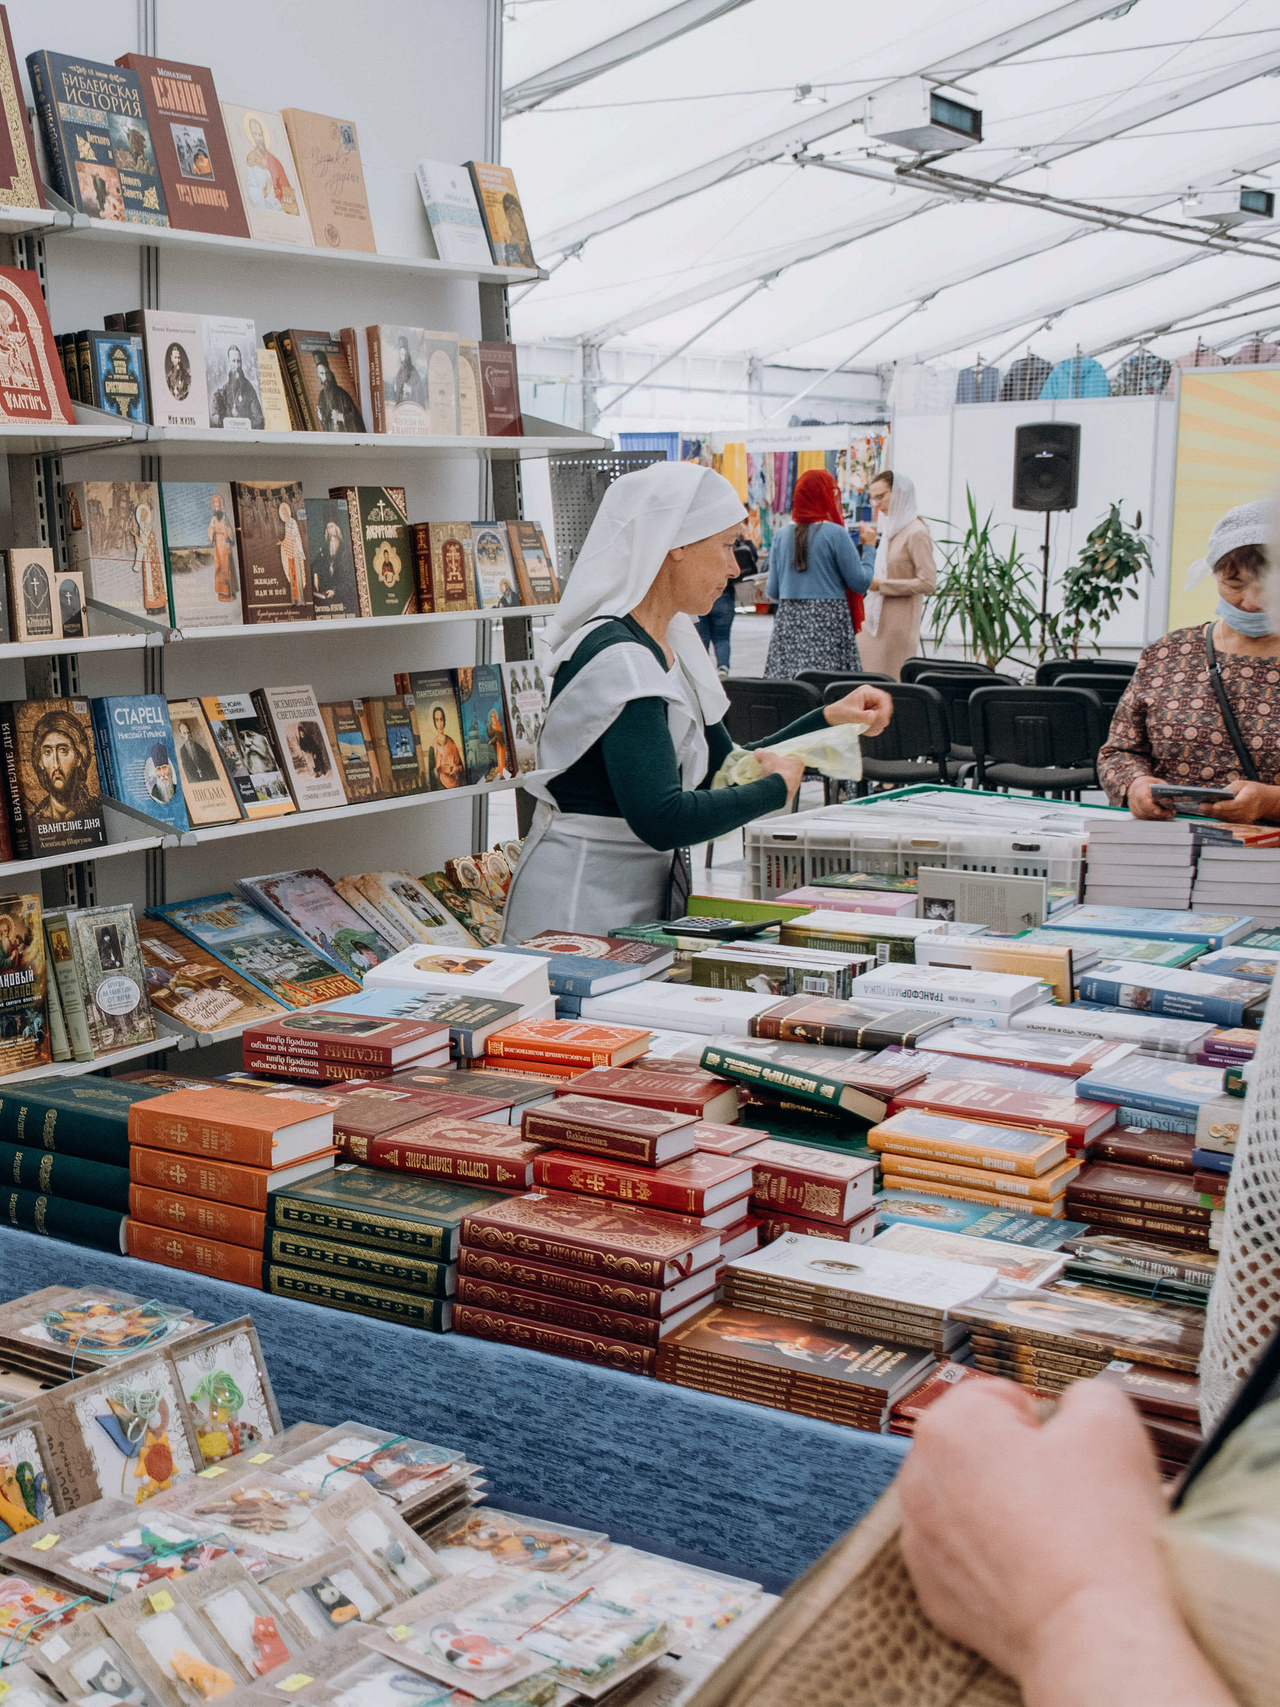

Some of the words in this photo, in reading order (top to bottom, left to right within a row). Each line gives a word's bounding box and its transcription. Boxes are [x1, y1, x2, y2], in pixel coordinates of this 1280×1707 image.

[62, 73, 139, 101] БИБЛЕЙСКАЯ
[65, 86, 143, 118] ИСТОРИЯ
[86, 131, 111, 147] Ветхого
[120, 173, 141, 188] Нового
[122, 187, 142, 200] Завета
[252, 564, 265, 574] Кто
[254, 577, 279, 586] жаждет,
[255, 589, 267, 597] иди
[275, 587, 287, 595] пей
[273, 697, 314, 710] ВСЕМИРНЫЙ
[114, 706, 164, 726] СТАРЕЦ
[276, 708, 317, 721] СВЕТИЛЬНИК
[0, 722, 13, 750] ДНЯ
[5, 751, 23, 822] ЕВАНГЕЛИЕ
[192, 786, 227, 803] ПИСЬМА
[38, 820, 82, 835] ЕВАНГЕЛИЕ
[83, 817, 101, 829] ДНЯ
[40, 838, 67, 849] Александр
[66, 836, 93, 847] Шаргунов
[863, 984, 944, 1003] ТРАНСФОРМАТУШКА
[178, 993, 218, 1019] Добрый
[201, 996, 235, 1020] портной
[250, 1042, 277, 1052] всякую
[266, 1035, 285, 1044] души
[286, 1037, 319, 1049] потребу
[266, 1055, 285, 1063] души
[288, 1047, 319, 1056] чтомые
[324, 1044, 384, 1063] ПСАЛМЫ
[504, 1046, 544, 1057] МОЛИТВОСЛОВ
[544, 1050, 591, 1062] ПРАВОСЛАВНЫЙ
[250, 1061, 277, 1071] всякую
[286, 1057, 319, 1067] потребу
[288, 1066, 319, 1075] чтомые
[762, 1067, 817, 1094] ПСАЛТИРЬ
[17, 1106, 28, 1139] БИБЛИЯ
[13, 1152, 23, 1183] БИБЛИЯ
[405, 1151, 453, 1174] ЕВАНГЕЛИЕ
[456, 1159, 489, 1179] СВЯТОЕ
[828, 1289, 848, 1298] ОПЫТ
[850, 1293, 897, 1310] ПОСТРОЕНИЯ
[898, 1303, 937, 1317] ИСПОВЕДИ
[826, 1309, 846, 1317] ОПЫТ
[848, 1313, 894, 1329] ПОСТРОЕНИЯ
[896, 1323, 934, 1337] ИСПОВЕДИ
[825, 1321, 846, 1330] ОПЫТ
[847, 1325, 894, 1340] ПОСТРОЕНИЯ
[896, 1335, 934, 1349] ИСПОВЕДИ
[57, 1440, 76, 1484] стекла
